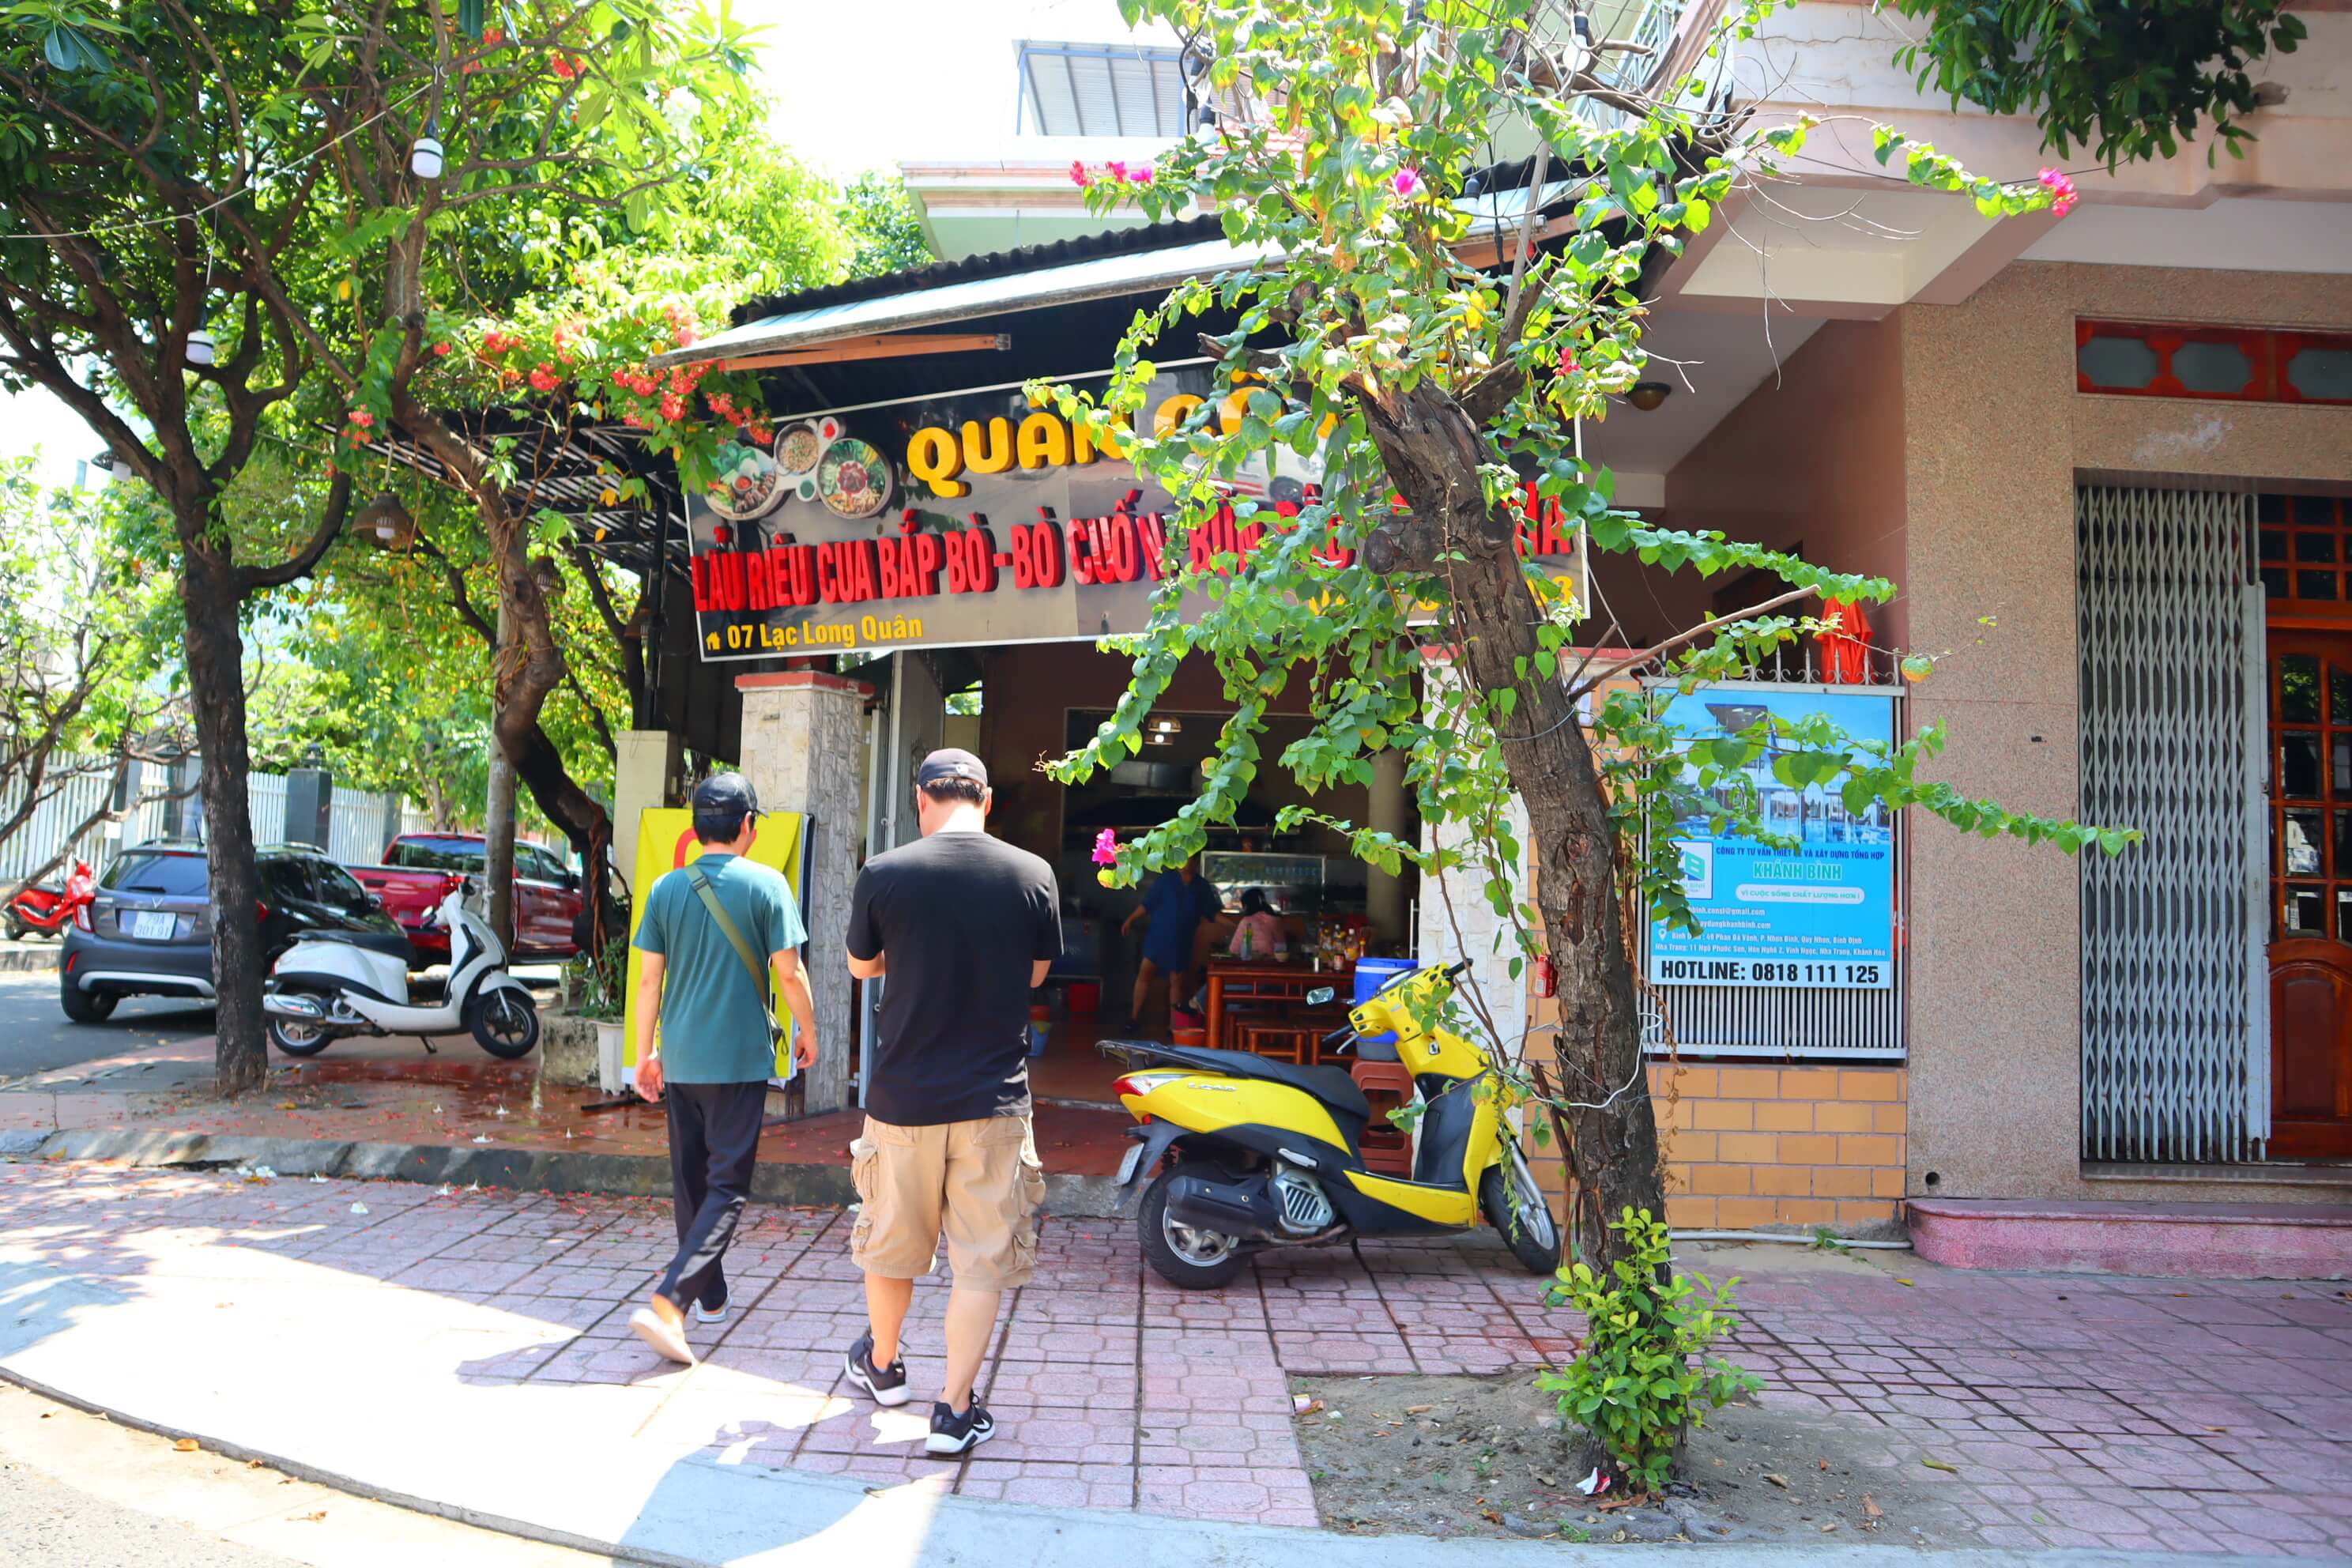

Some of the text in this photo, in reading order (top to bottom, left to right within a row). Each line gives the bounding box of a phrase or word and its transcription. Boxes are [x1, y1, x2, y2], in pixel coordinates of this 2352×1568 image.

[746, 532, 819, 610] RIÊU
[816, 539, 879, 604] CUA
[877, 508, 942, 598] BẮP
[727, 614, 923, 651] 07 Lạc Long Quân
[1753, 860, 1842, 880] KHÁNH BÌNH
[1661, 960, 1879, 983] HOTLINE: 0818 111 125
